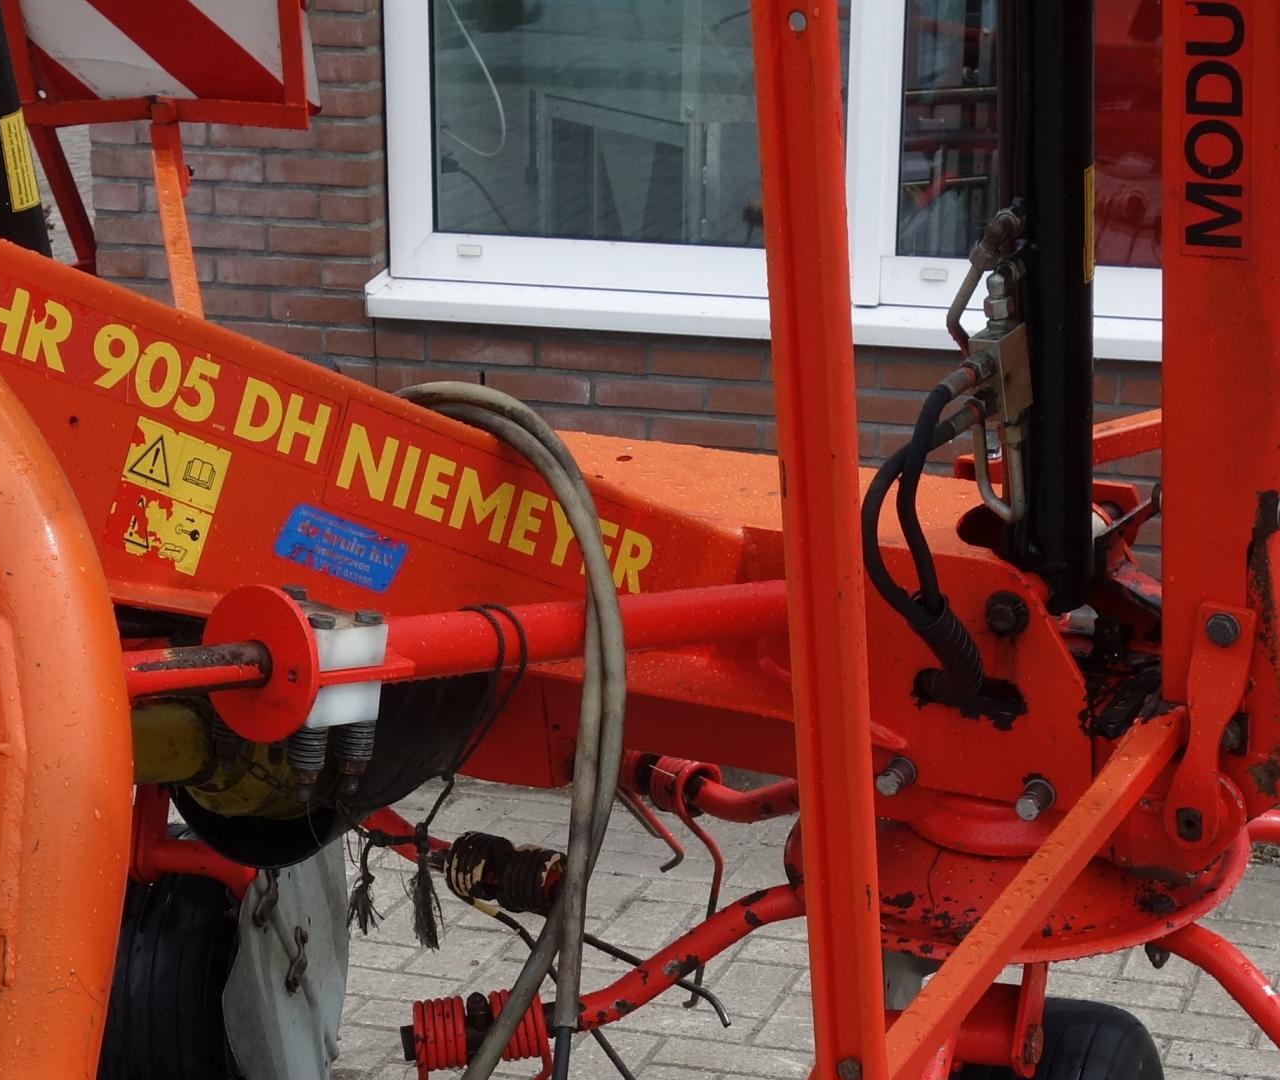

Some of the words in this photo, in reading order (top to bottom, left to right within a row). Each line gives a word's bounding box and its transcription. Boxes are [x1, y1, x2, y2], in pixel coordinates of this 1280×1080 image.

[1184, 1, 1245, 248] MODU
[93, 323, 221, 423] 905
[233, 376, 332, 465] DH
